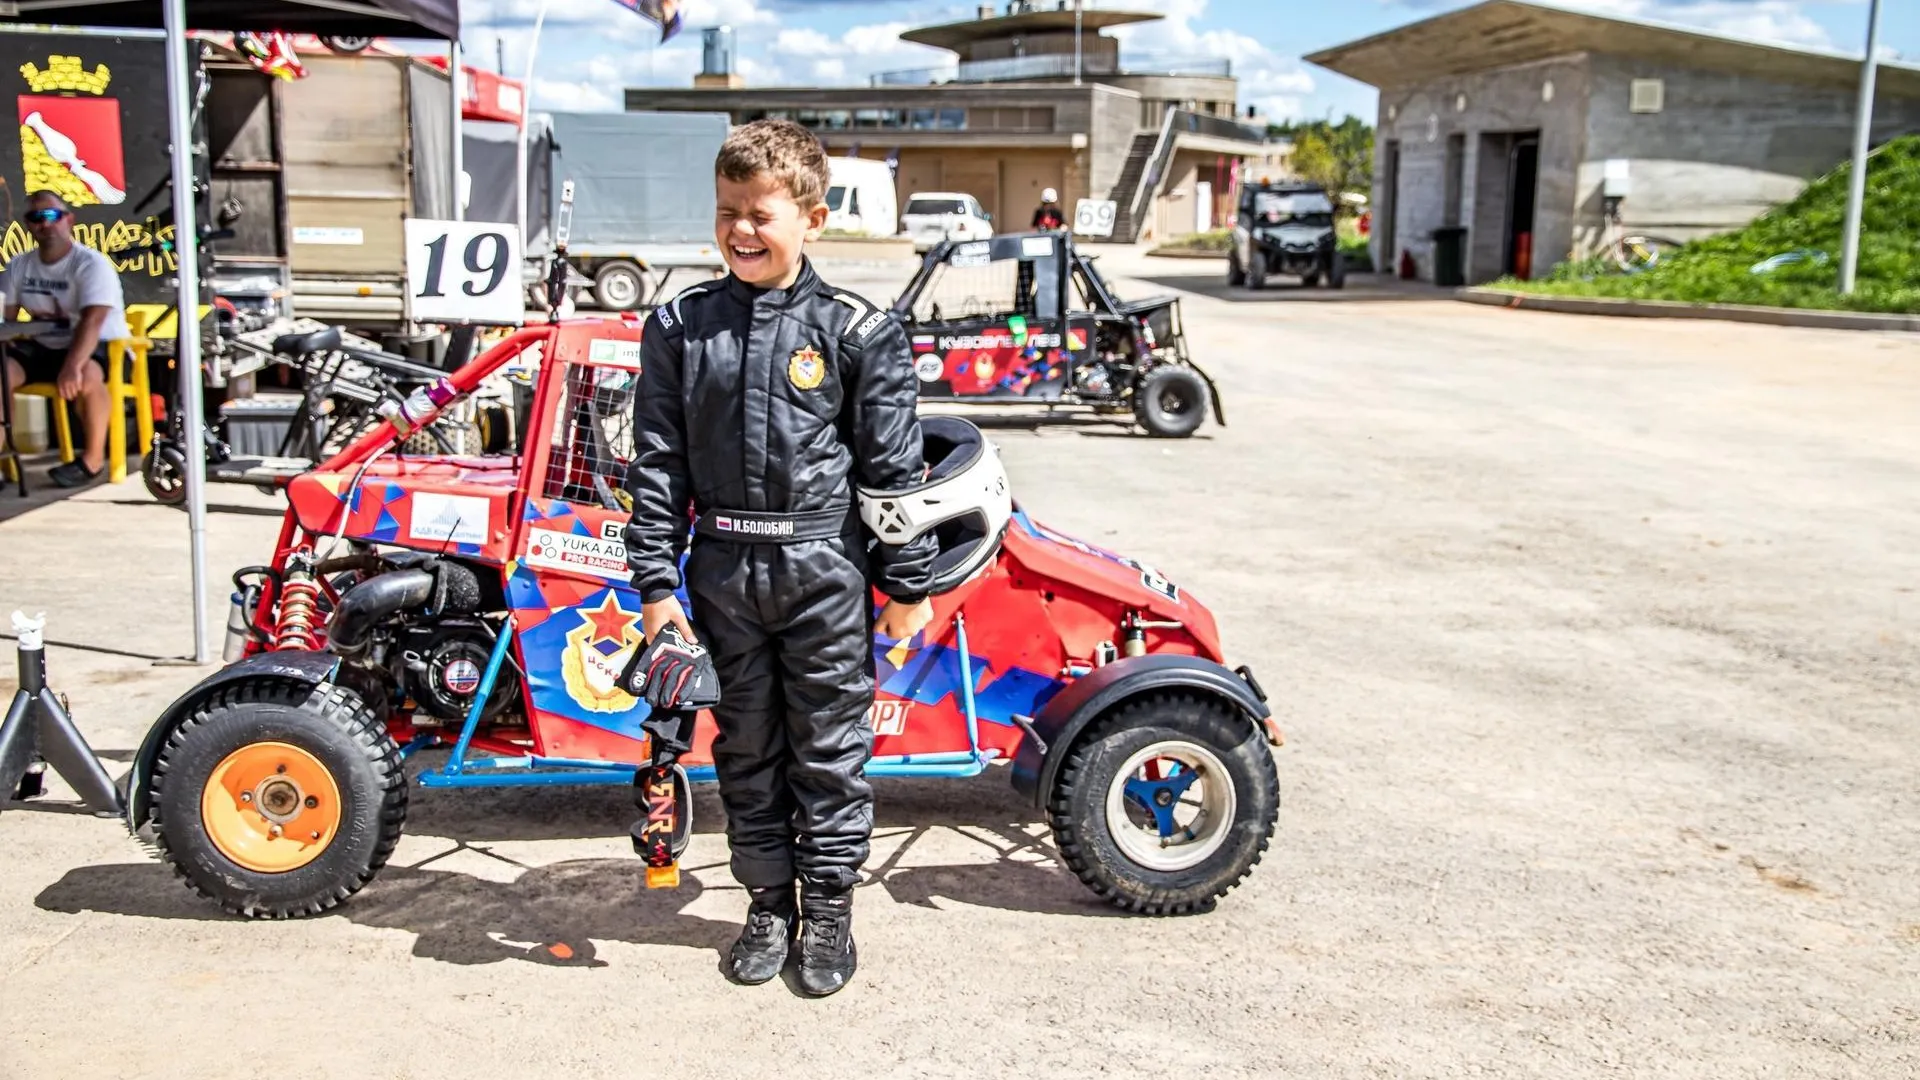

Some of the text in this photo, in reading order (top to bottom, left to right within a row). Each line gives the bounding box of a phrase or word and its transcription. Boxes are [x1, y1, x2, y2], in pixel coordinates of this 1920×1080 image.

[1077, 203, 1113, 228] 69
[416, 232, 510, 298] 19
[938, 335, 1018, 350] КУЗОВЛЕ
[733, 519, 794, 535] И.БОЛОБИН
[561, 537, 601, 555] YUKA
[564, 553, 625, 572] PRO RACING
